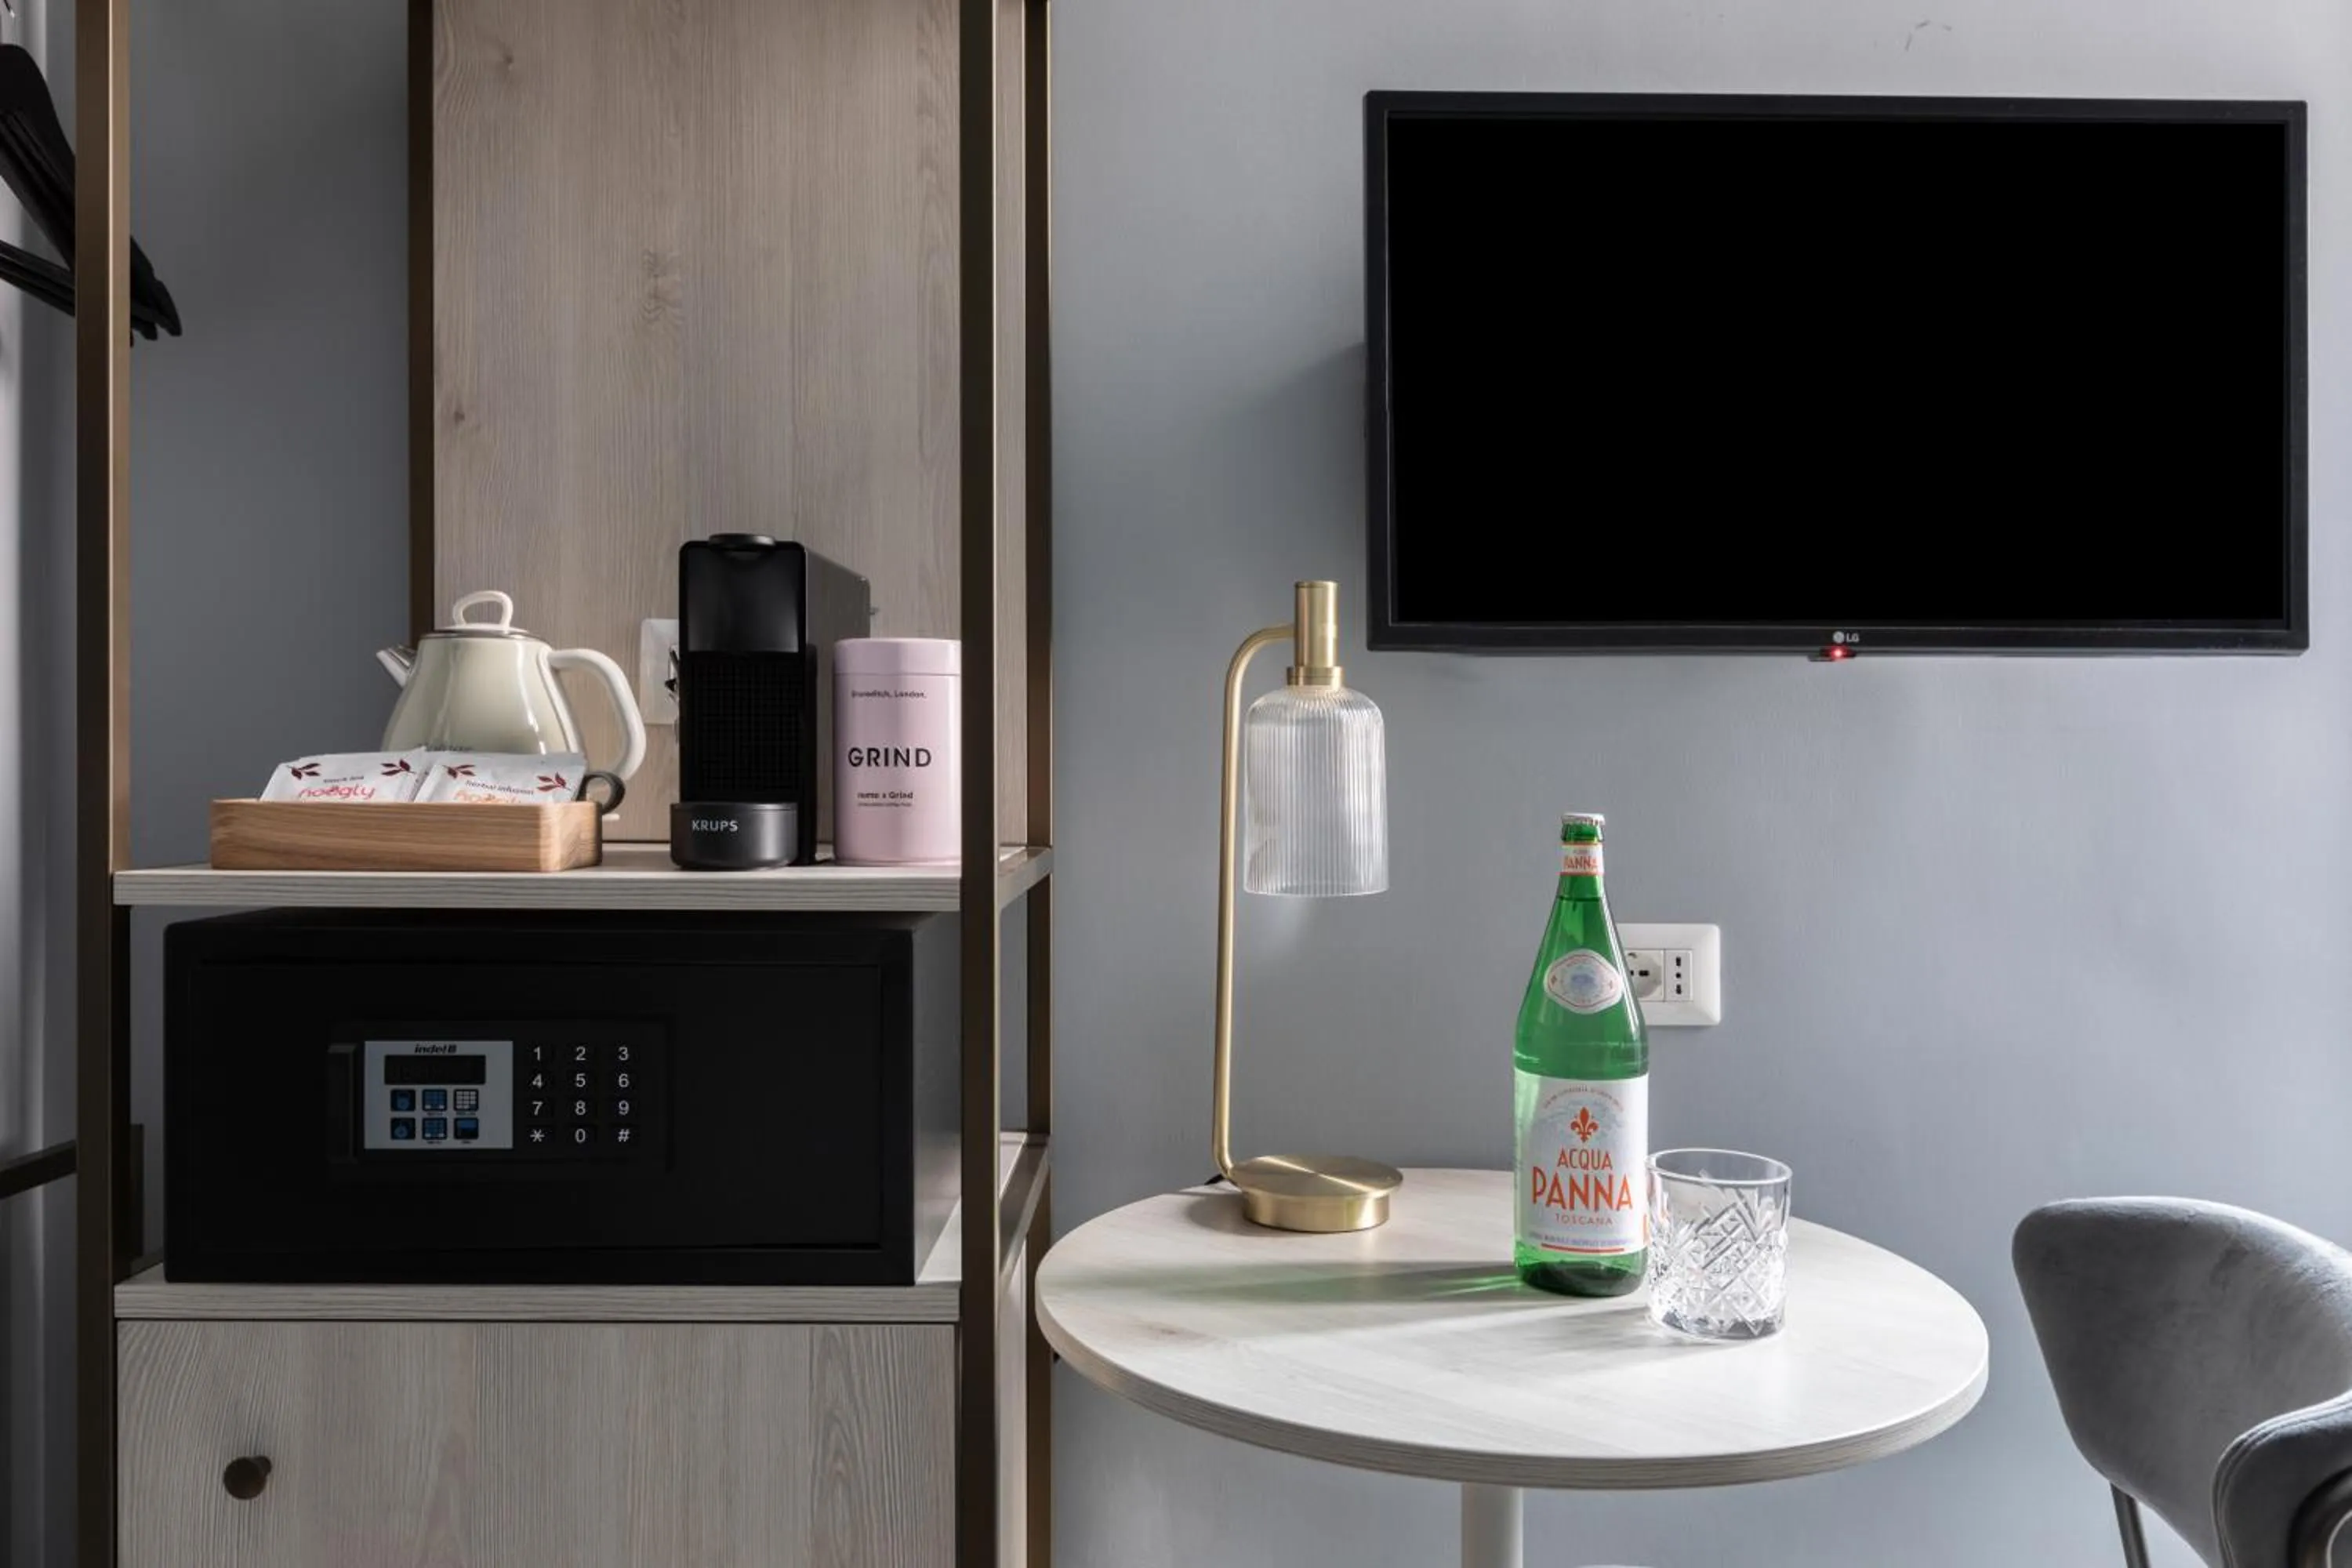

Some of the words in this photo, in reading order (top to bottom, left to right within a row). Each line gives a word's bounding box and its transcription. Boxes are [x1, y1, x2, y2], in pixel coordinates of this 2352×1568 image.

[848, 746, 932, 768] GRIND
[691, 819, 739, 832] KRUPS
[533, 1047, 541, 1061] 1
[575, 1047, 586, 1061] 2
[619, 1047, 629, 1061] 3
[532, 1074, 543, 1087] 4
[576, 1073, 586, 1087] 5
[619, 1073, 630, 1087] 6
[532, 1101, 543, 1115] 7
[575, 1100, 586, 1115] 8
[619, 1100, 630, 1115] 9
[575, 1128, 586, 1143] 0
[618, 1128, 630, 1142] #
[1557, 1147, 1613, 1171] ACQUA
[1531, 1166, 1633, 1212] PANNA
[1555, 1213, 1613, 1225] TOSCANA
